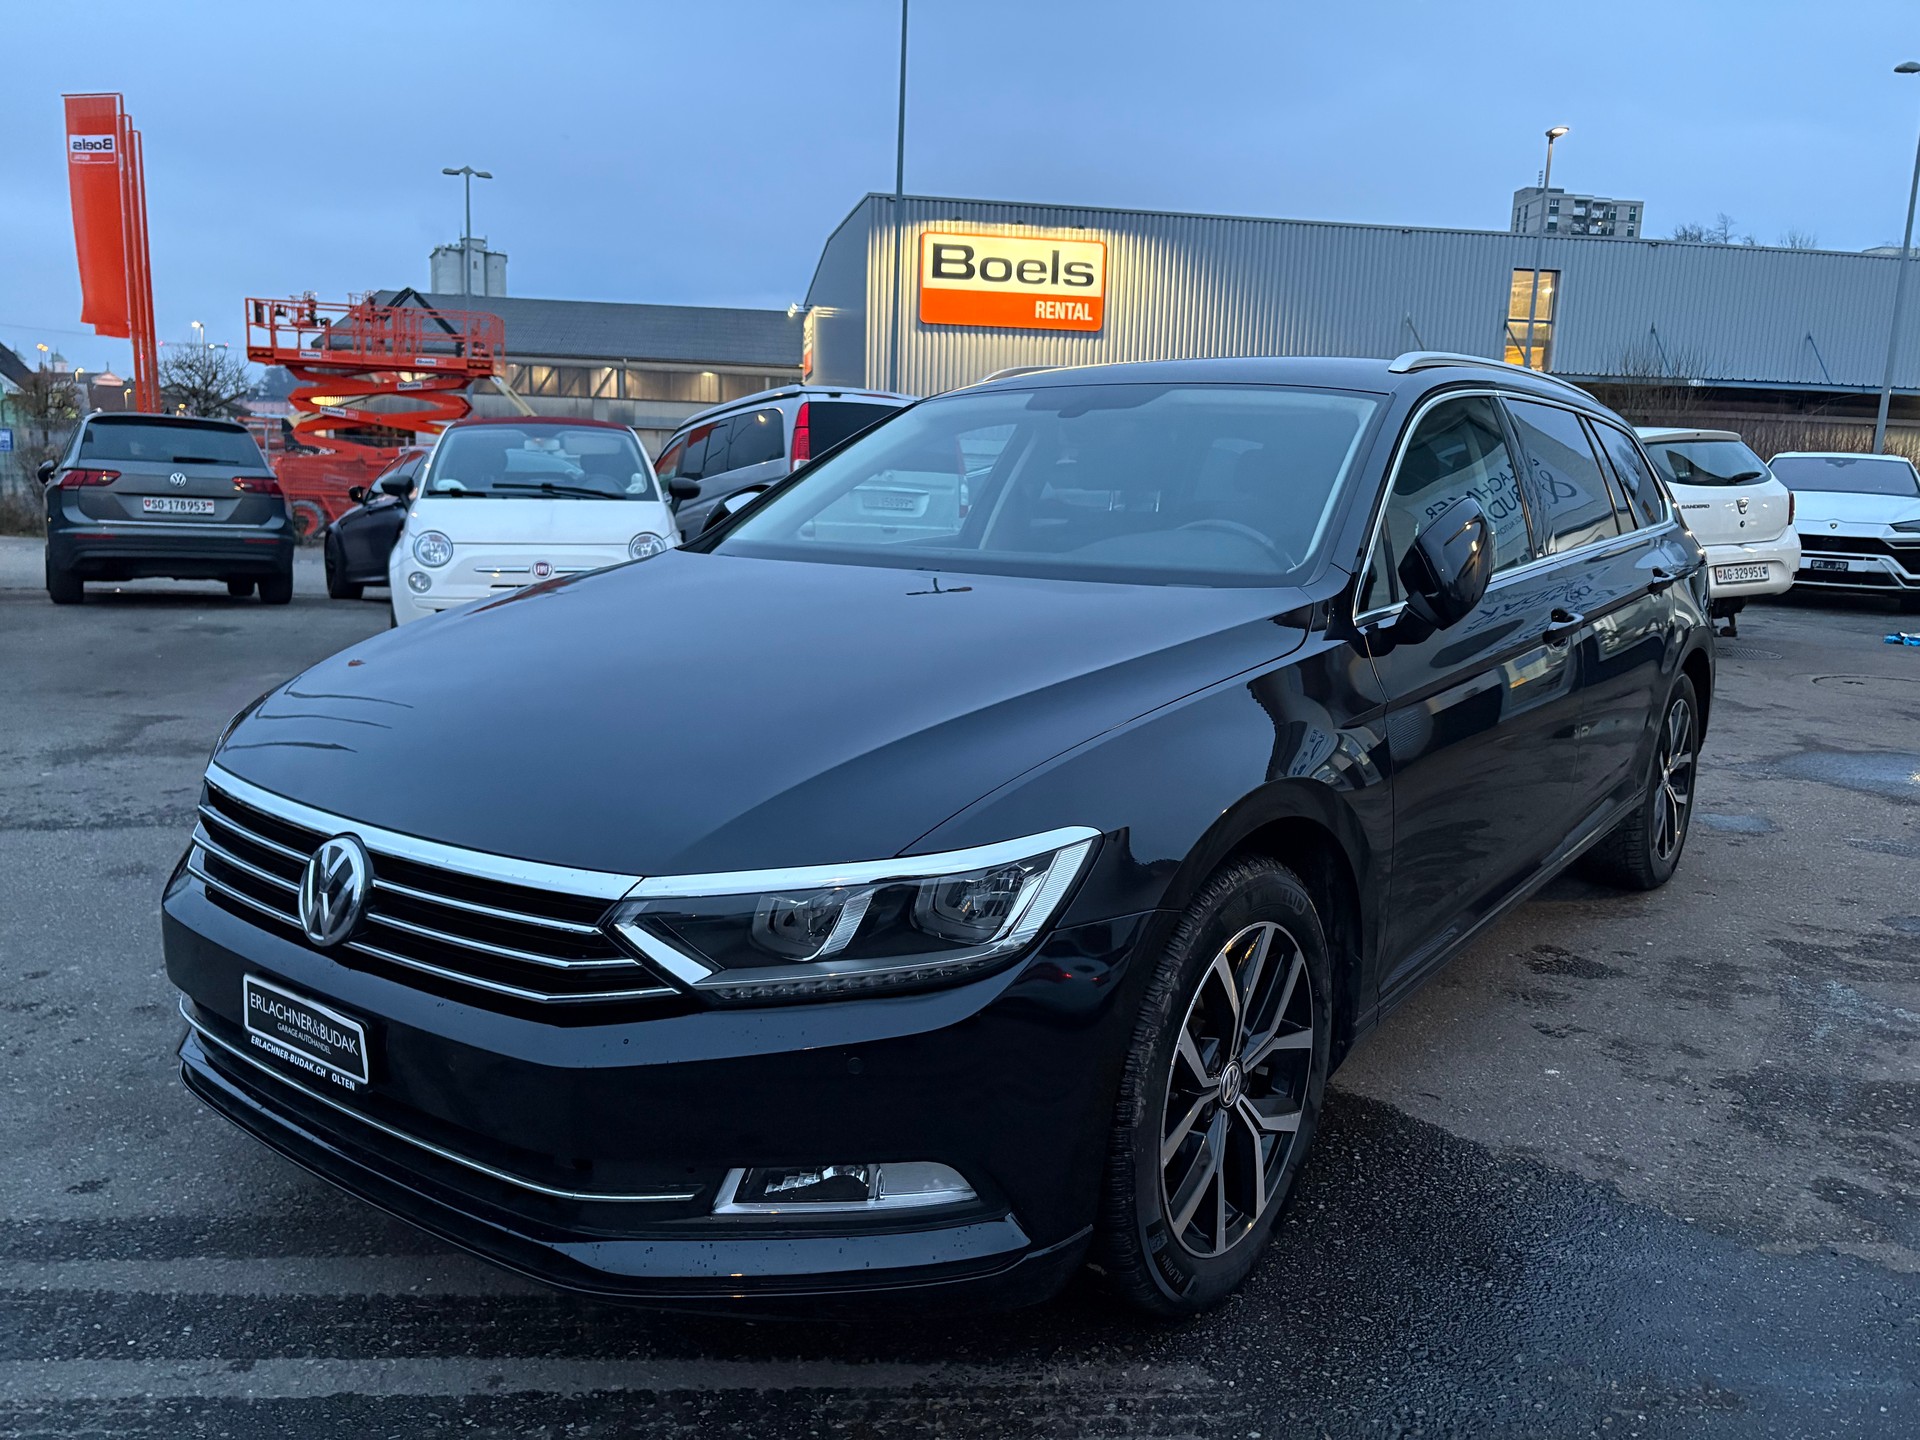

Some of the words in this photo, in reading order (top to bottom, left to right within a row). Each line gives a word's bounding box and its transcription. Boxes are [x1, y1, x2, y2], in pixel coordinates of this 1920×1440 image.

[932, 242, 1094, 287] Boels
[1035, 300, 1093, 321] RENTAL
[250, 992, 358, 1056] ERLACHNER&BUDAK
[277, 1022, 298, 1038] GARAGE
[298, 1032, 332, 1055] AUTOHANDEL
[251, 1035, 326, 1077] ERLACHNER-BUDAK.CH
[331, 1073, 356, 1091] OLTEN
